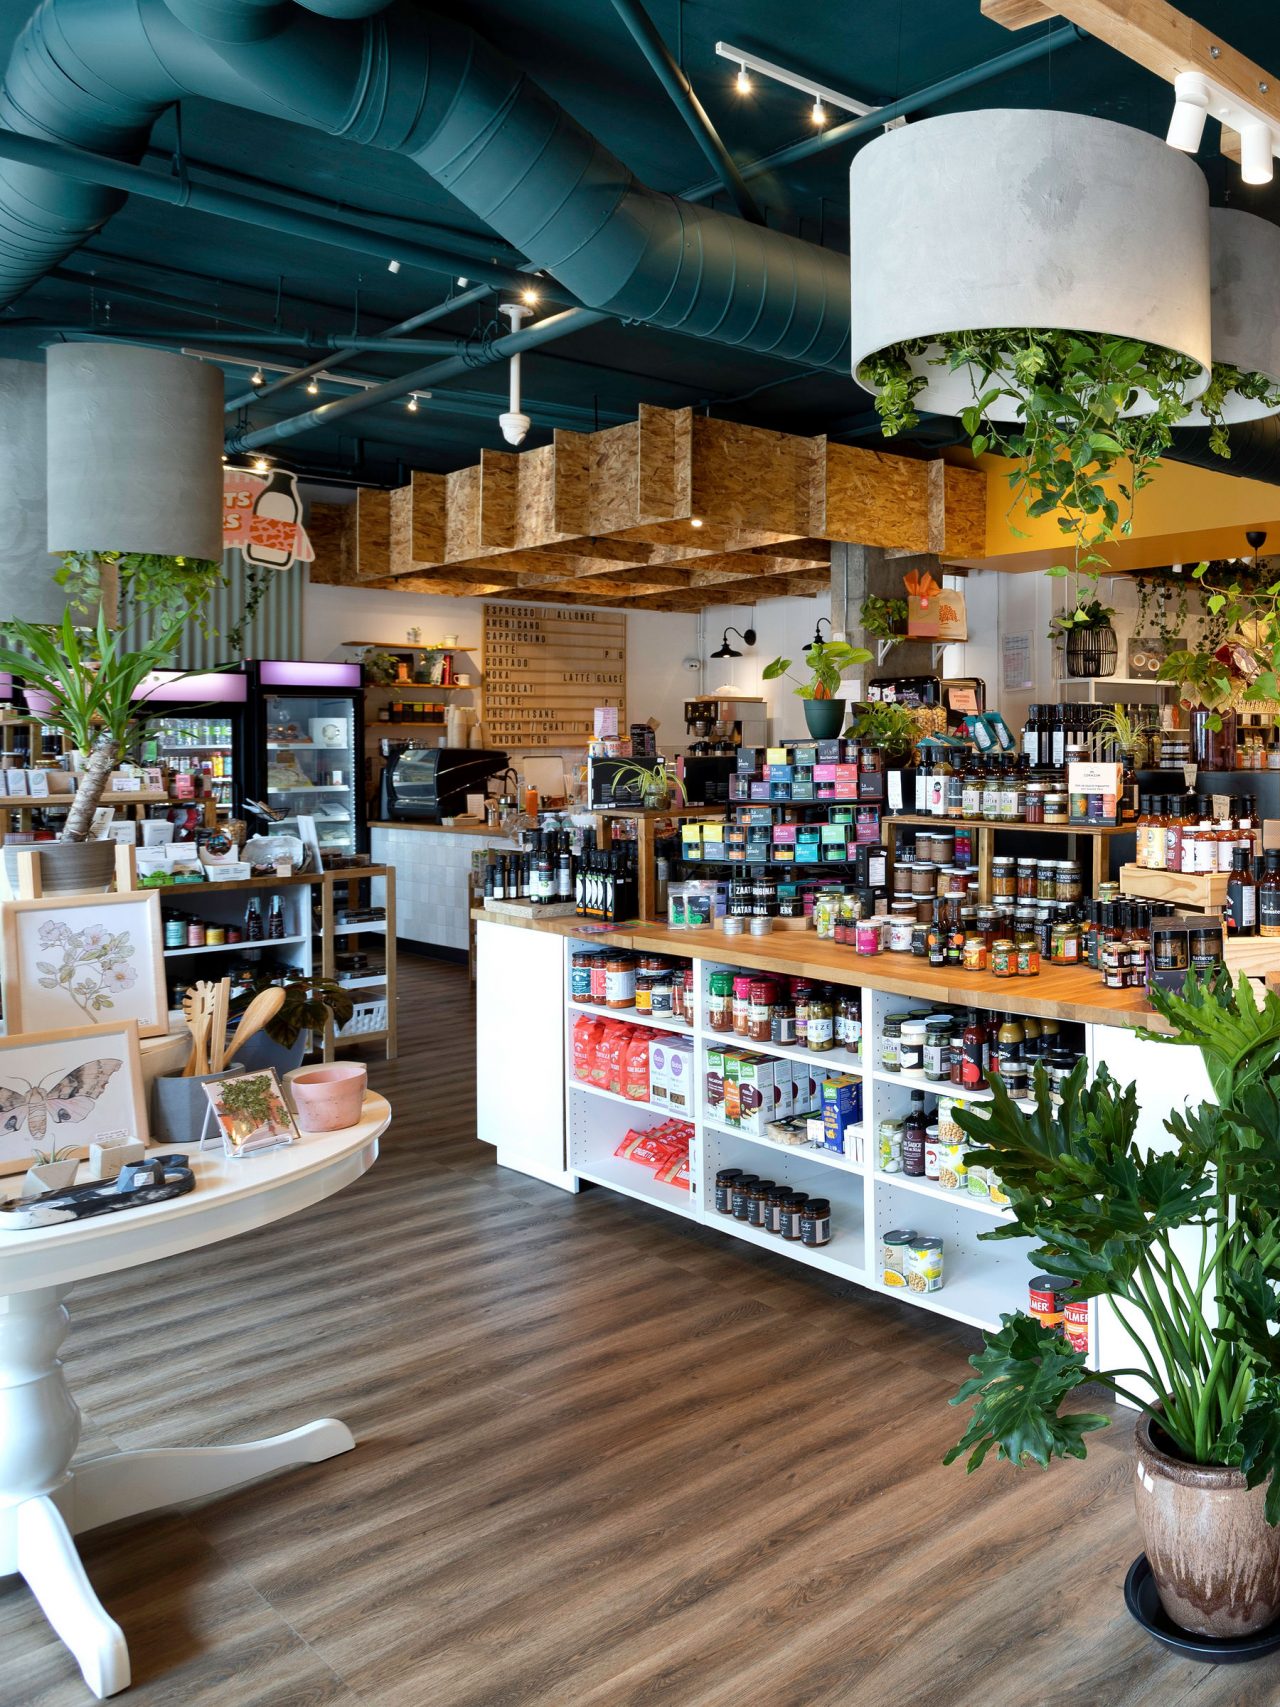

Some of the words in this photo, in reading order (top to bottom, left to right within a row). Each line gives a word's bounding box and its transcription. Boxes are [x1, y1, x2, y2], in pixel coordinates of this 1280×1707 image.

[486, 606, 534, 616] ESPRESSO
[486, 618, 540, 630] AMERICANO
[486, 632, 546, 643] CAPPUCCINO
[486, 658, 528, 668] CORTADO
[486, 670, 509, 680] MOKA
[486, 684, 533, 692] CHOCOLAT
[486, 696, 521, 706] FILTRE
[520, 710, 554, 718] TISANE
[492, 736, 522, 744] ONDON
[531, 736, 548, 744] FOG
